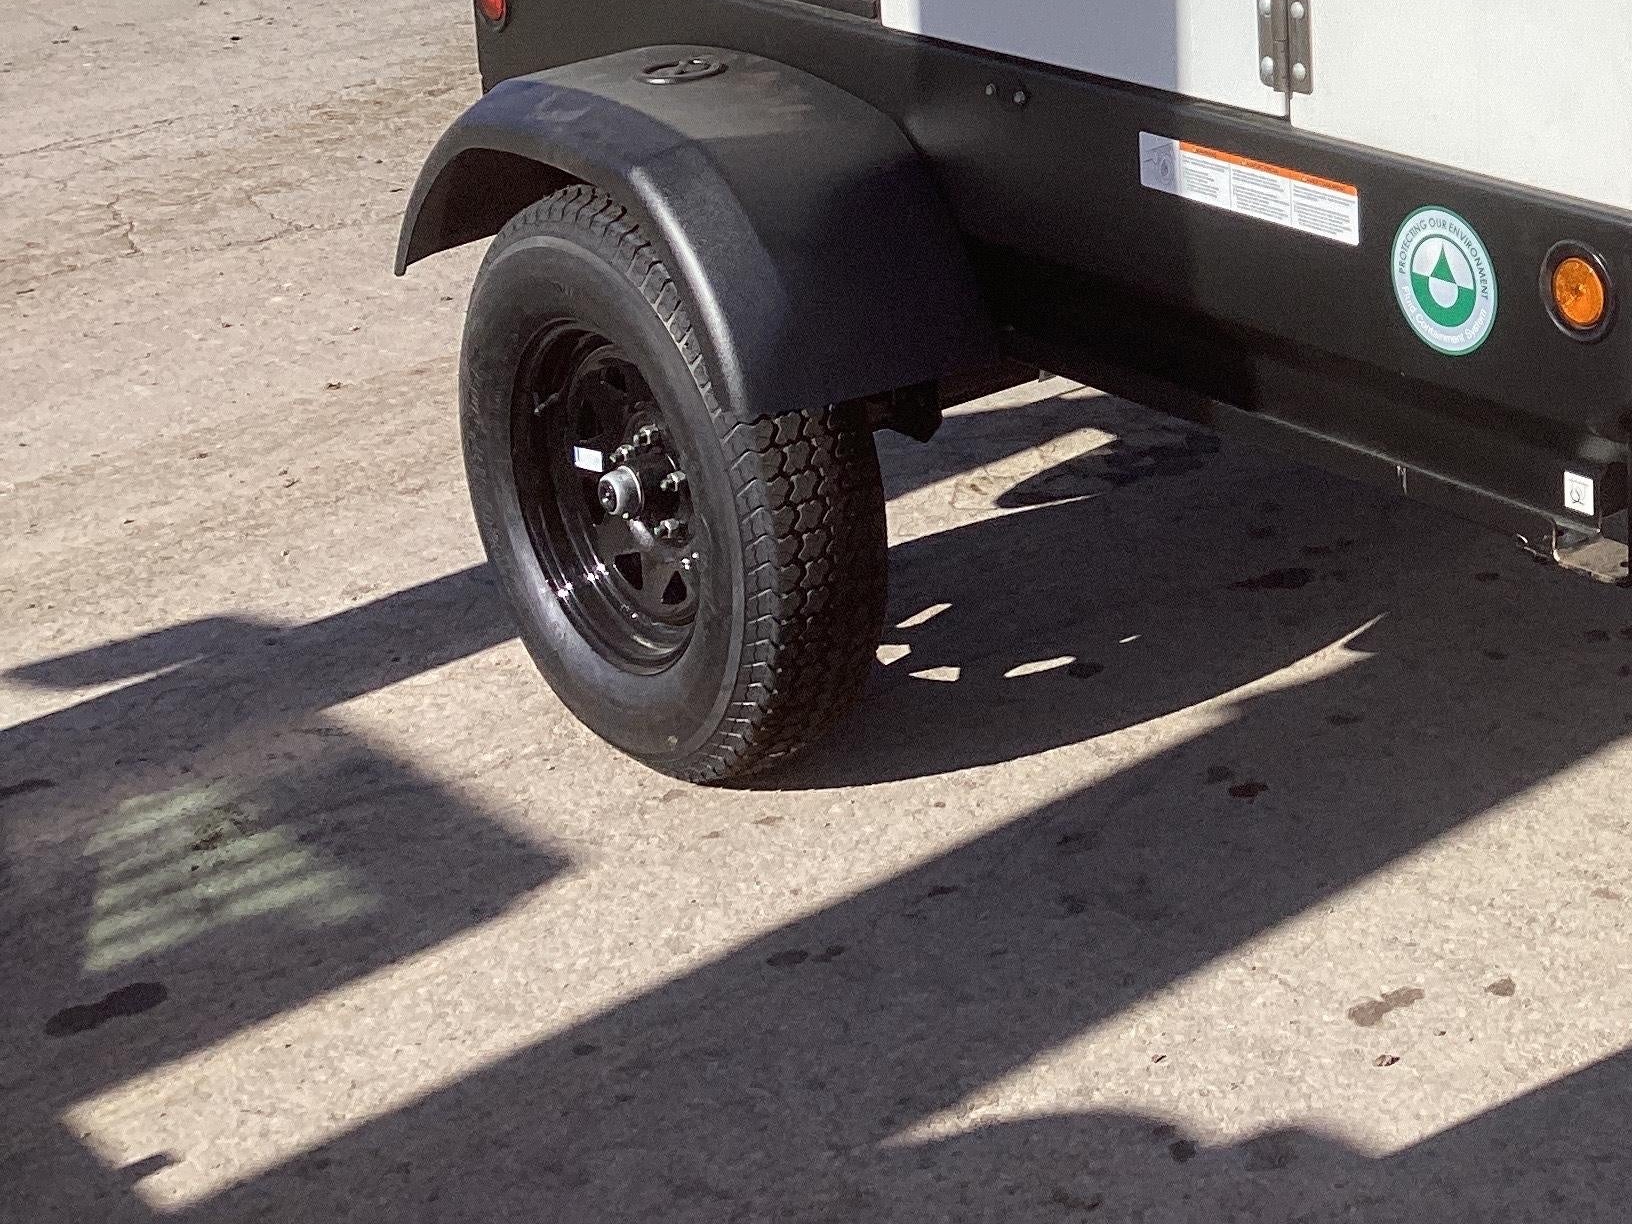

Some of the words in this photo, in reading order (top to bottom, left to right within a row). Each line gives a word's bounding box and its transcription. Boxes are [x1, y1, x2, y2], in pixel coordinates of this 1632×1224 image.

[1399, 218, 1428, 275] PROTECTING
[1428, 217, 1448, 230] OUR
[1448, 222, 1489, 301] ENVIRONMENT
